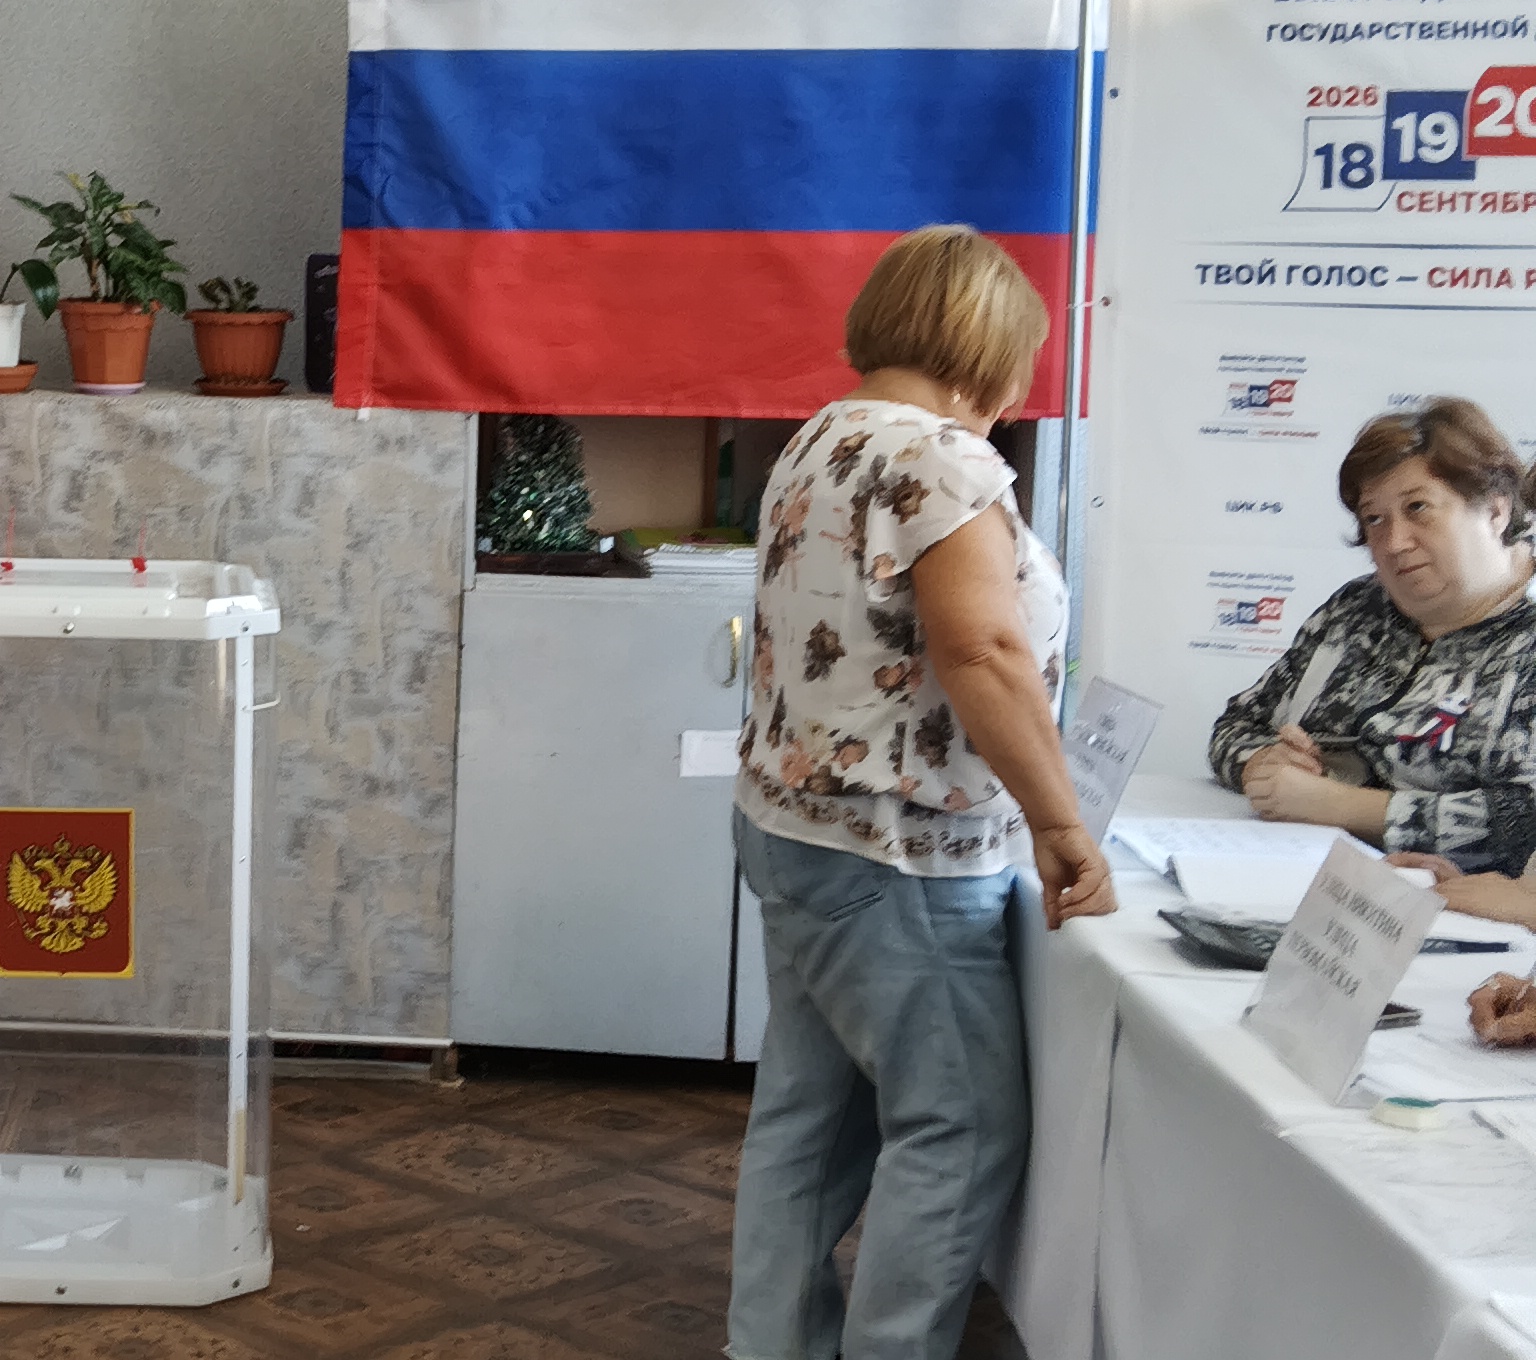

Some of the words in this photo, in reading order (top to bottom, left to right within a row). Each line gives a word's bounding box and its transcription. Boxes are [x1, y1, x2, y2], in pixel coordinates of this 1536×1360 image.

[1266, 15, 1528, 44] ГОСУДАРСТВЕННОЙ
[1307, 86, 1378, 107] 2026
[1391, 111, 1461, 164] 19
[1314, 143, 1374, 190] 18
[1195, 259, 1277, 285] ТВОЙ
[1286, 265, 1388, 287] ГОЛОС
[1428, 267, 1512, 288] СИЛА
